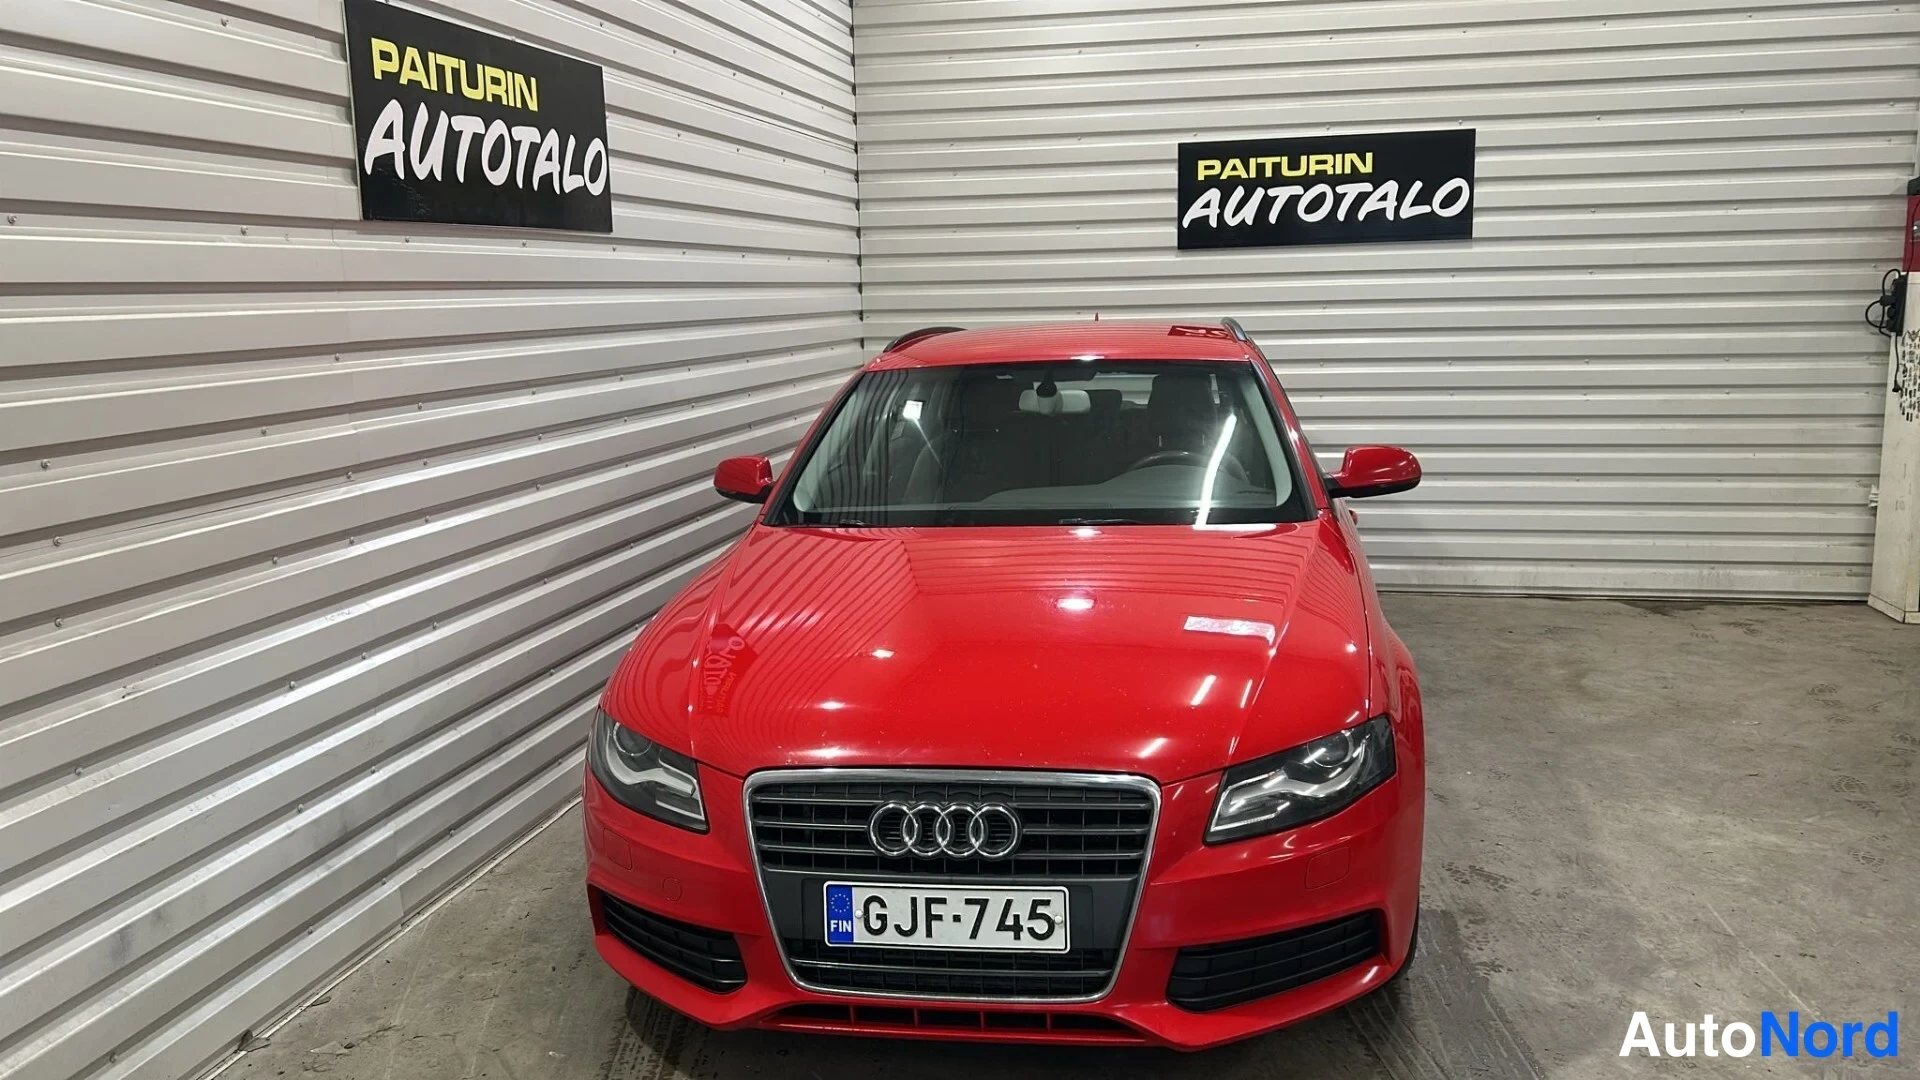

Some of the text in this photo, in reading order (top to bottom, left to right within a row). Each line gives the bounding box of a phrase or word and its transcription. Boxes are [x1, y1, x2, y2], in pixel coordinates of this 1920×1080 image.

[371, 37, 538, 112] PAITURIN
[364, 99, 607, 196] AUTOTALO
[1197, 152, 1373, 181] PAITURIN
[1182, 177, 1470, 228] AUTOTALO
[830, 920, 852, 933] FIN
[863, 895, 1056, 941] GJF-745
